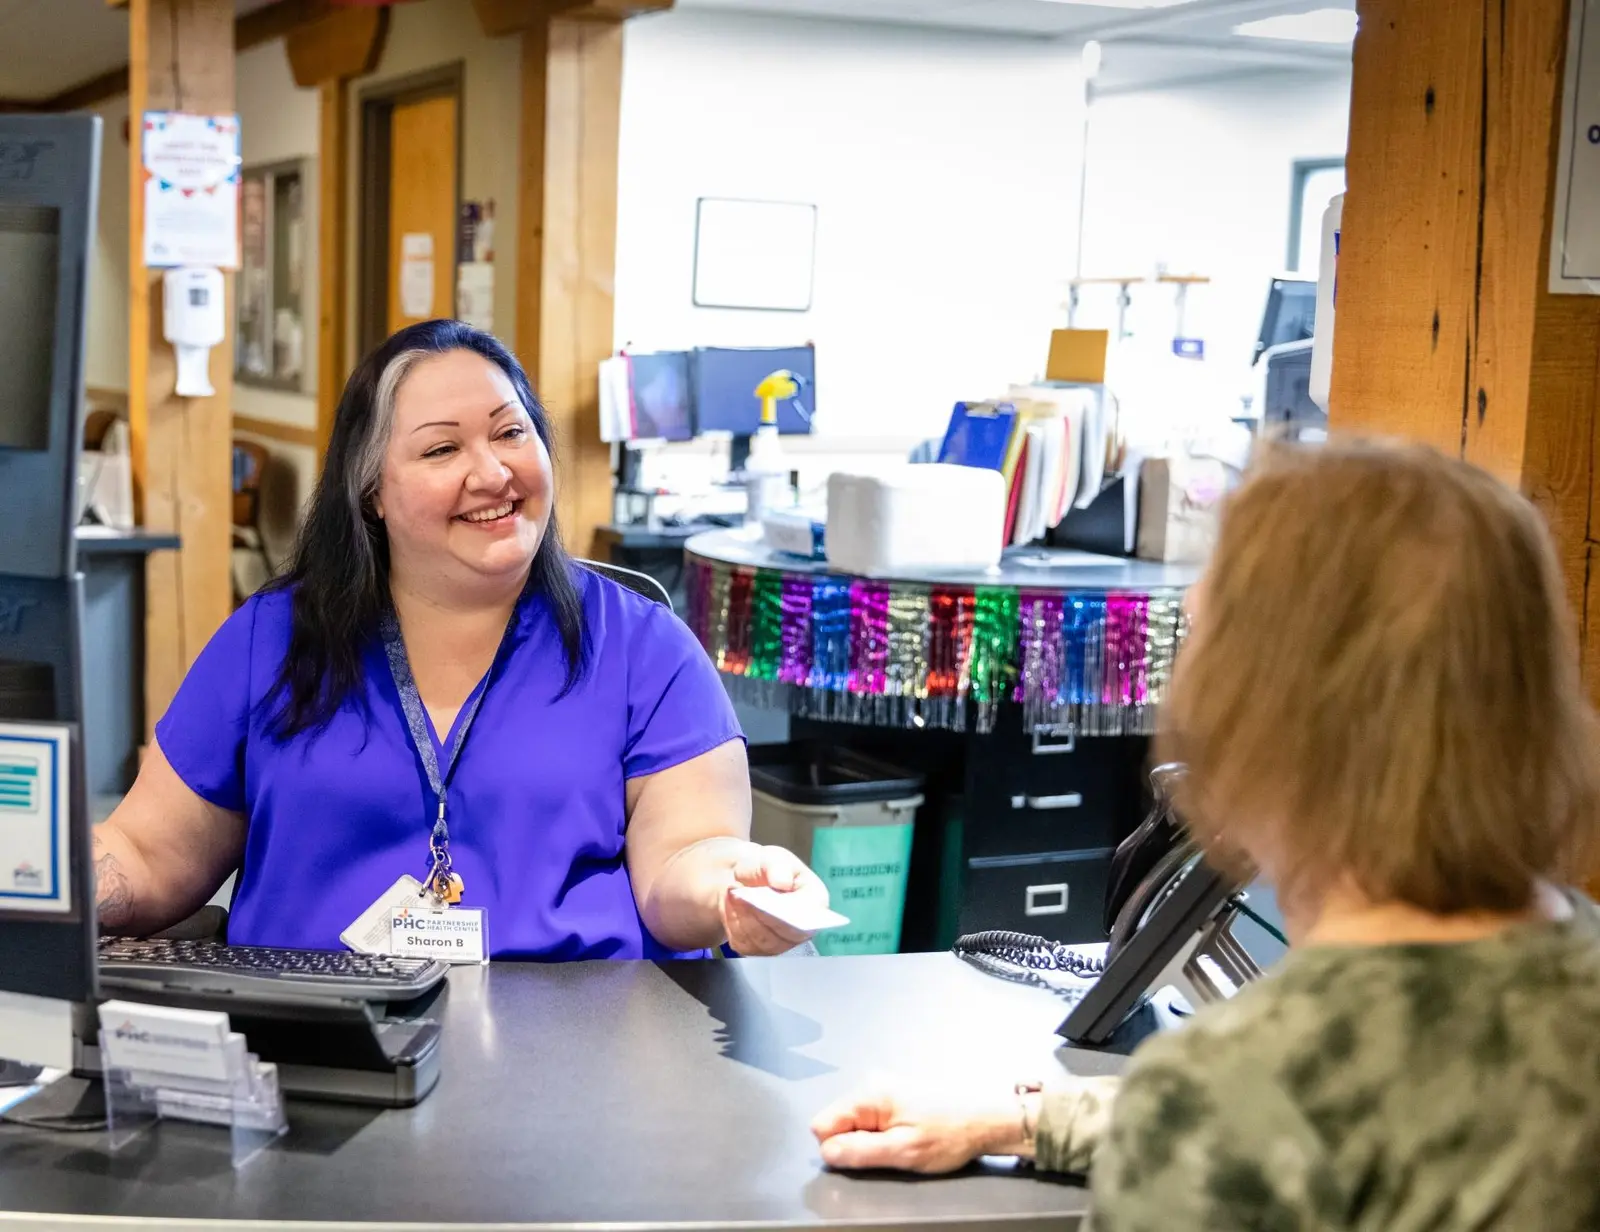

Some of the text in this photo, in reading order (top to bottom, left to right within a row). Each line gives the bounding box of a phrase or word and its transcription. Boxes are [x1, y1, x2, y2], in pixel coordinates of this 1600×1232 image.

[393, 918, 426, 930] PHC
[427, 919, 479, 927] PARTNERSHIP
[407, 936, 464, 948] Sharon B
